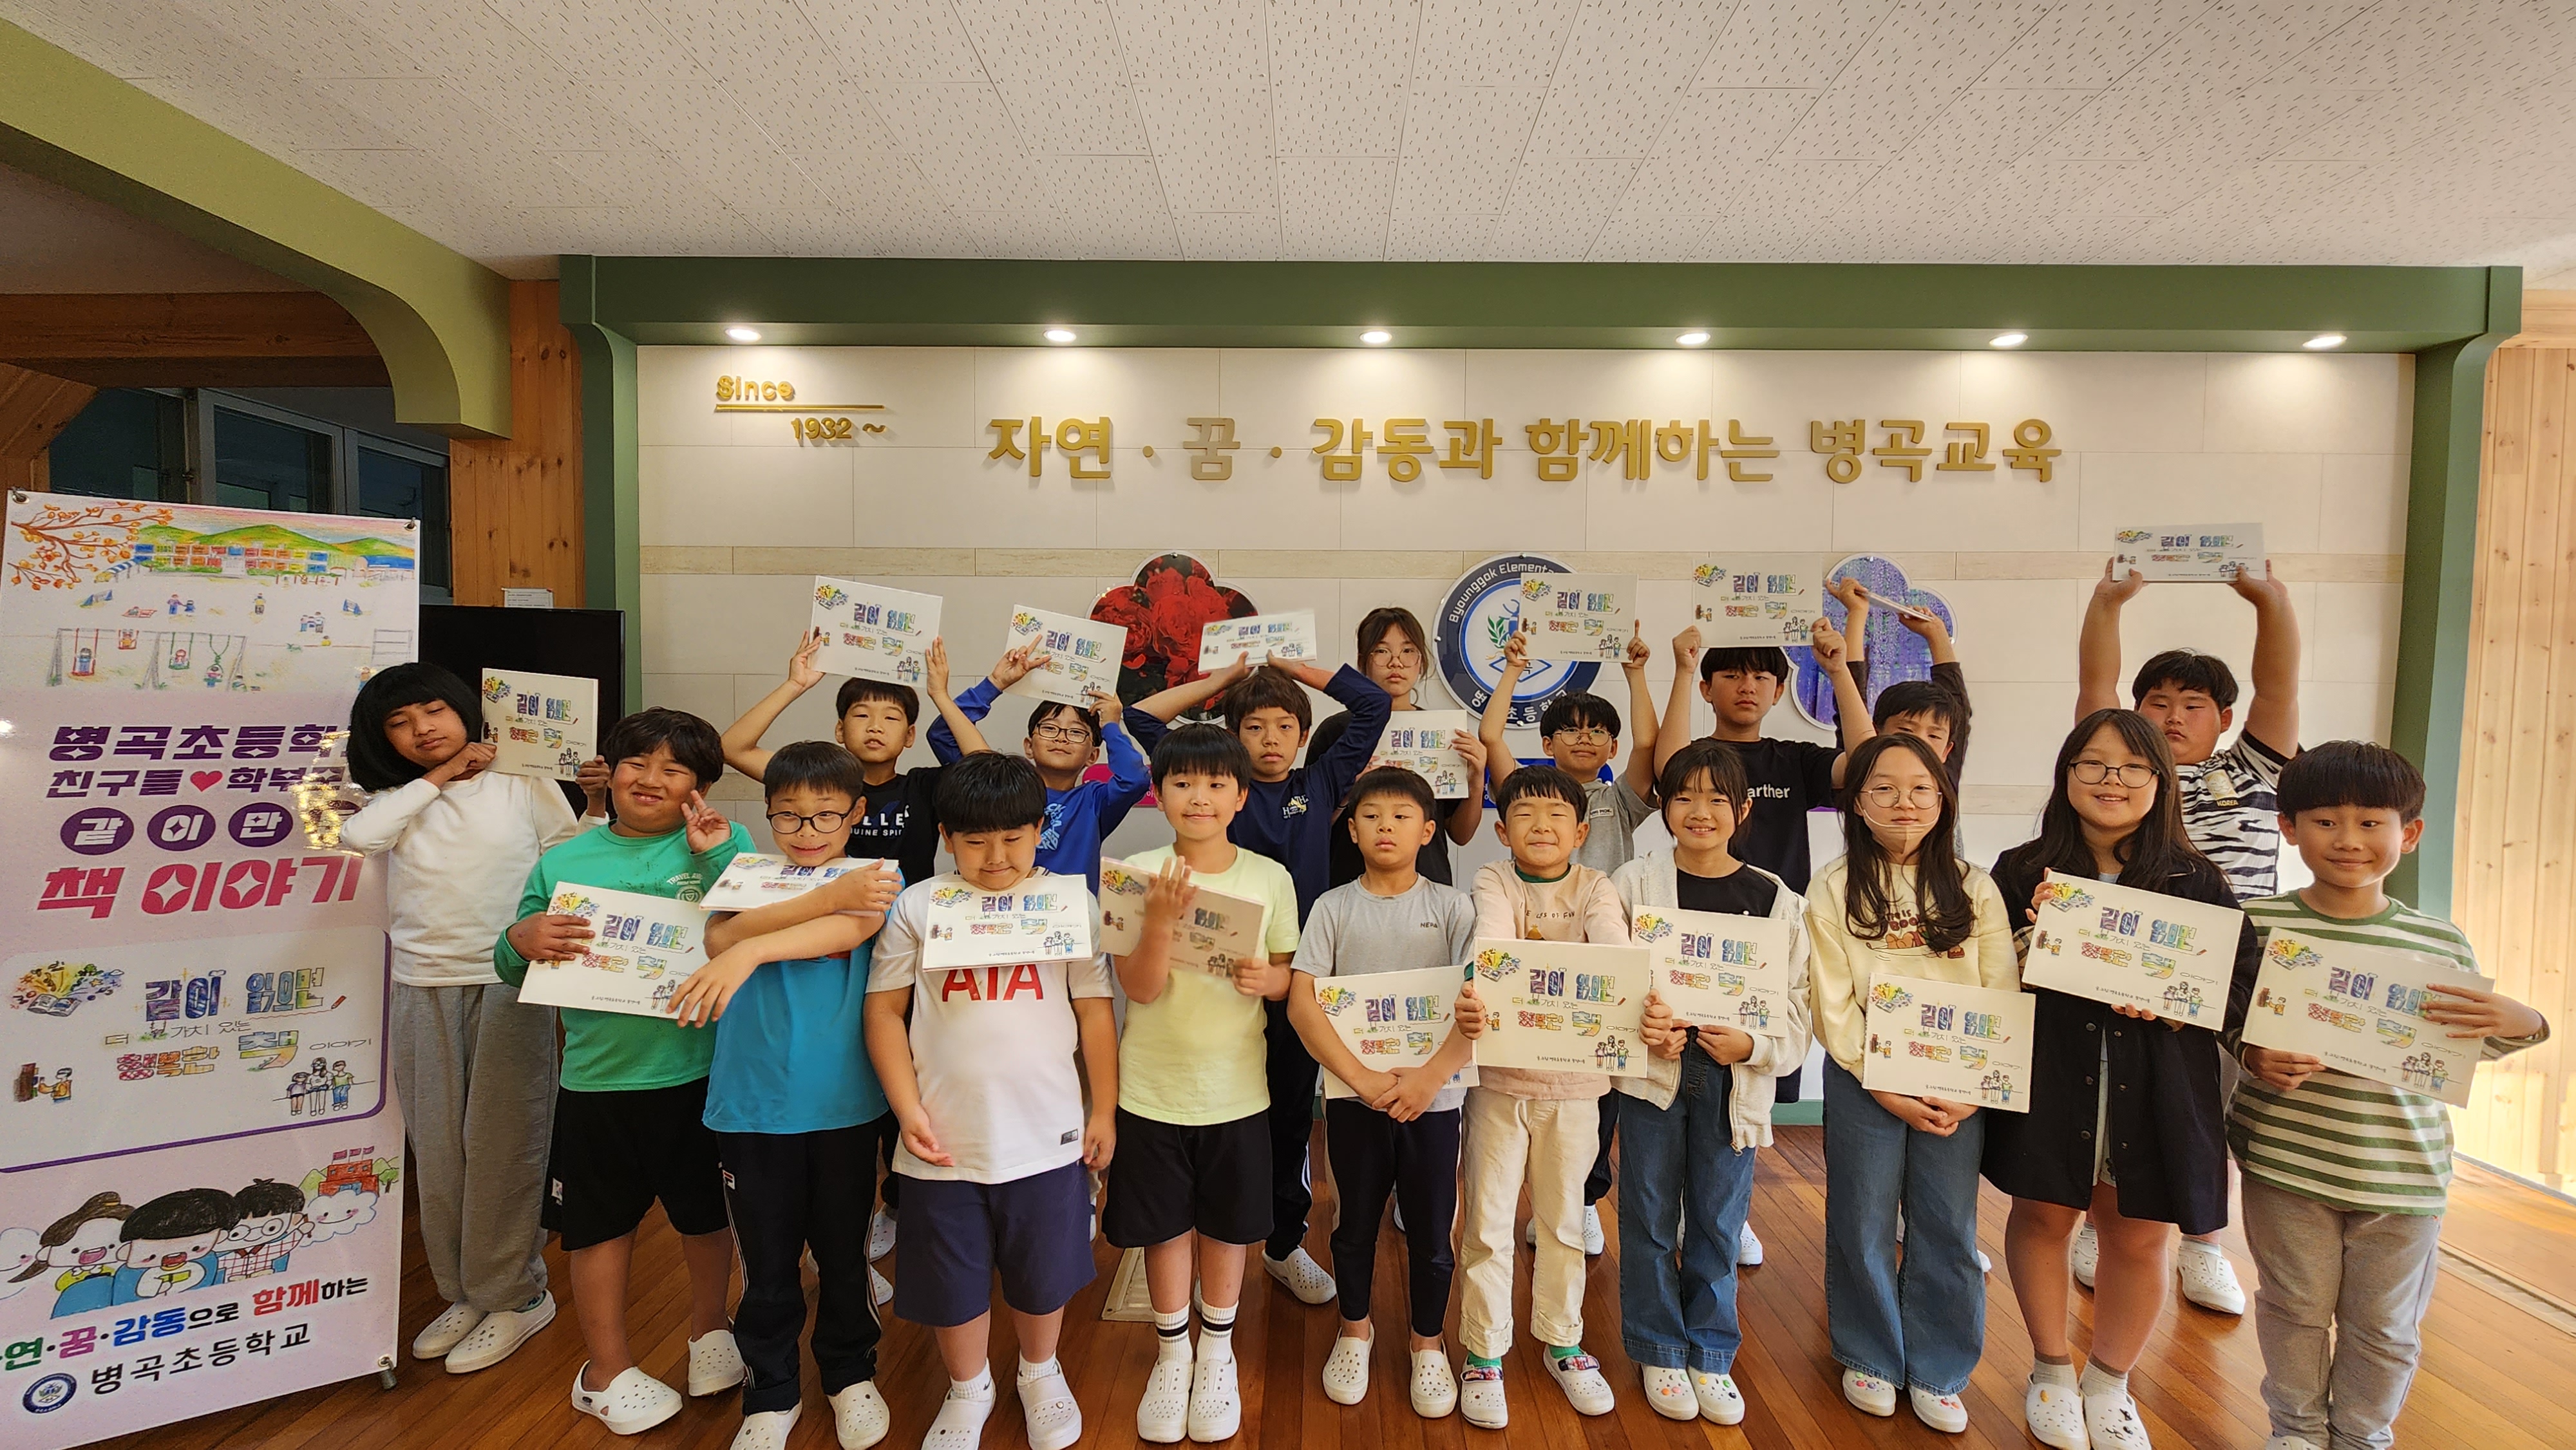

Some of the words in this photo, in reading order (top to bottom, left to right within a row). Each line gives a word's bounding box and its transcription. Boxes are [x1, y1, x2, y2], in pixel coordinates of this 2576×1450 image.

[715, 375, 795, 400] Since
[791, 417, 852, 439] 1932
[989, 416, 1112, 479] 자연
[1183, 417, 1240, 481] 꿈
[1312, 418, 1503, 482] 감동과
[1526, 419, 1780, 482] 함께하는
[1811, 419, 2061, 483] 병곡교육
[1449, 567, 1498, 623] Byounggok
[1499, 562, 1554, 574] Elementa
[49, 725, 348, 761] 병곡초등학
[1747, 784, 1790, 798] arther
[37, 867, 125, 919] 책
[141, 855, 365, 914] 이야기
[602, 914, 643, 942] 같이
[2099, 907, 2143, 937] 같이
[2150, 919, 2197, 951] 읽으면
[1681, 933, 1714, 959] 같이
[1722, 939, 1757, 966] 읽으면
[2141, 952, 2175, 979] 책
[146, 971, 227, 1021] 같이
[246, 967, 325, 1014] 읽으면
[942, 964, 1044, 1002] AIA
[1530, 967, 1567, 997] 같이
[1577, 974, 1615, 1002] 읽으면
[1718, 973, 1745, 996] 책
[2328, 966, 2378, 1001] 같이
[1365, 994, 1396, 1022] 같이
[1405, 995, 1441, 1021] 읽으면
[1572, 1011, 1601, 1037] 책
[1921, 1004, 1956, 1031] 같이
[1964, 1012, 2001, 1040] 읽으면
[238, 1030, 299, 1069] 책
[1406, 1032, 1433, 1055] 책
[2376, 1018, 2417, 1049] 책
[1960, 1046, 1987, 1070] 책
[252, 1277, 368, 1316] 함께하는
[91, 1323, 310, 1396] 병곡초등학교
